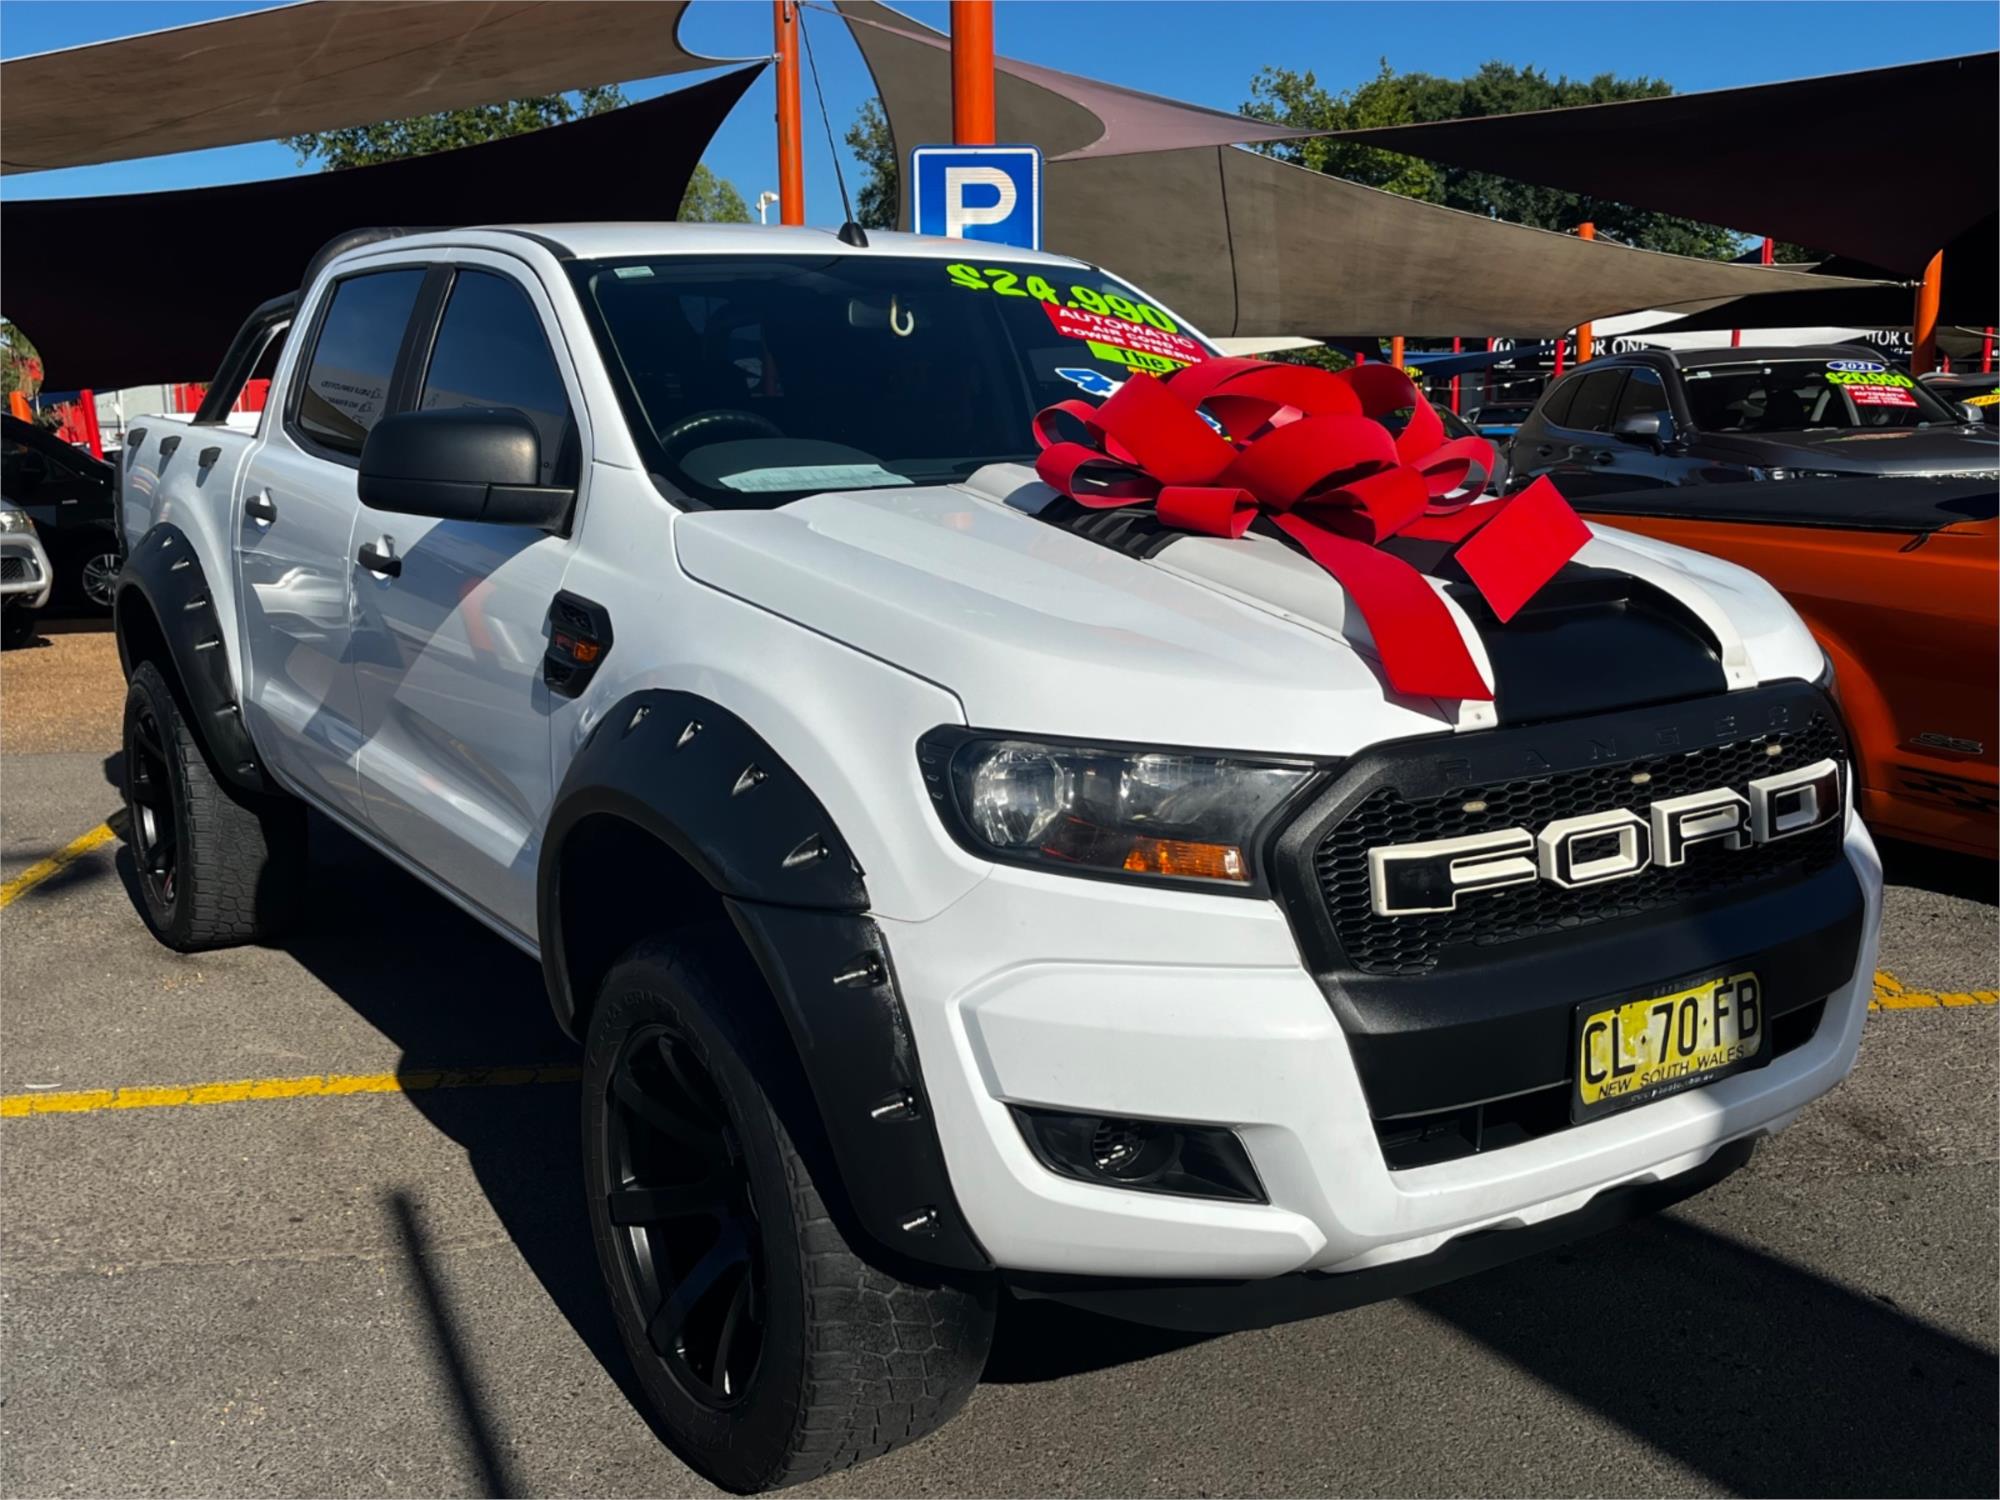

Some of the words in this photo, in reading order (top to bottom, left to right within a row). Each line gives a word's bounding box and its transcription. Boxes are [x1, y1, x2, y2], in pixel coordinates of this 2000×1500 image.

[945, 167, 1017, 239] P
[1059, 308, 1195, 350] AUTOMATIC
[1060, 325, 1126, 345] POWER
[1129, 340, 1202, 363] STEERIN
[1092, 325, 1122, 337] AIR
[1113, 347, 1167, 371] The
[1437, 705, 1790, 783] RANGER
[1368, 757, 1843, 917] FORD
[1597, 1077, 1633, 1098] NEW
[1639, 1061, 1691, 1088] SOUTH
[1696, 1044, 1745, 1068] WALES
